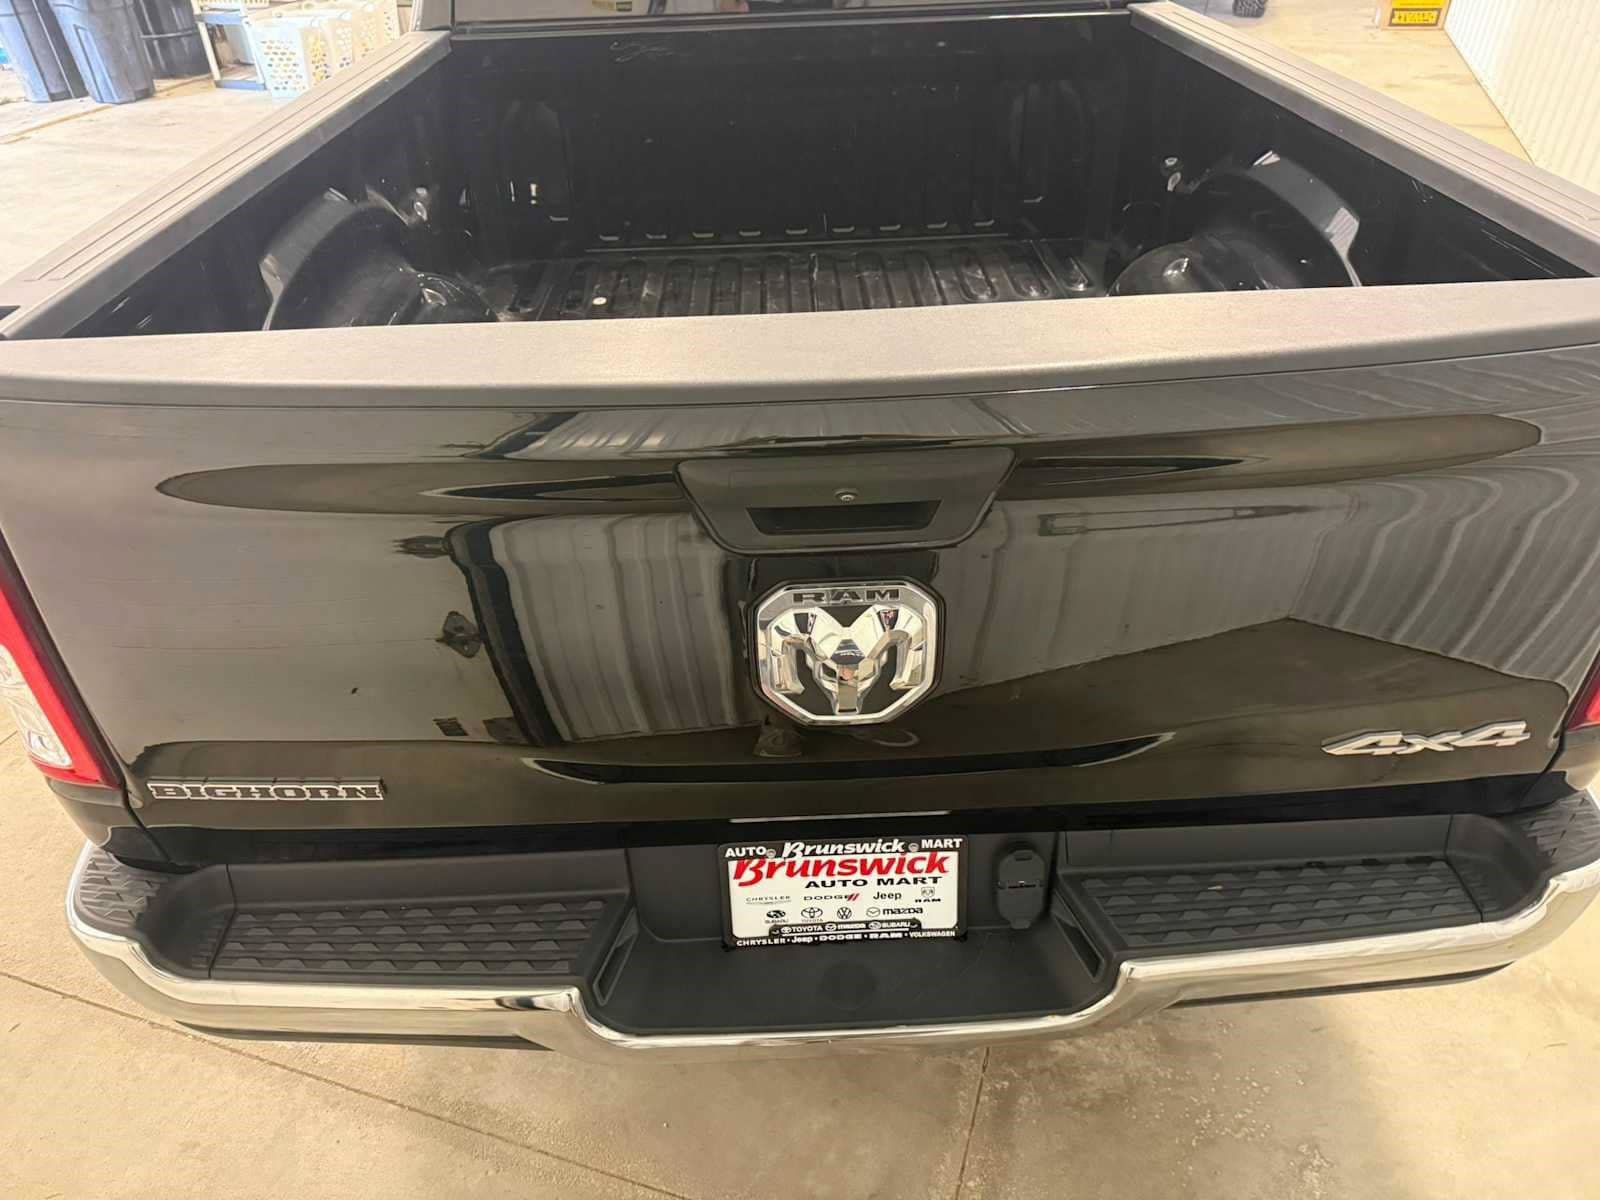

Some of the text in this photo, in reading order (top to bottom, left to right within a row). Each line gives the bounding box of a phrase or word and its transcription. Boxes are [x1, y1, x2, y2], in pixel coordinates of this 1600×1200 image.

[792, 589, 900, 603] RAM
[147, 782, 384, 801] BIGHORN
[725, 838, 963, 858] AUTO Brunswick MART
[733, 851, 950, 887] Brunswick
[805, 876, 943, 888] AUTO MART
[873, 891, 902, 901] Jeep
[883, 906, 924, 916] mazda
[791, 925, 824, 933] TOYOTA
[736, 930, 956, 947] CHRYSLER Jeep DODGE RAM VOLKSWAGEN
